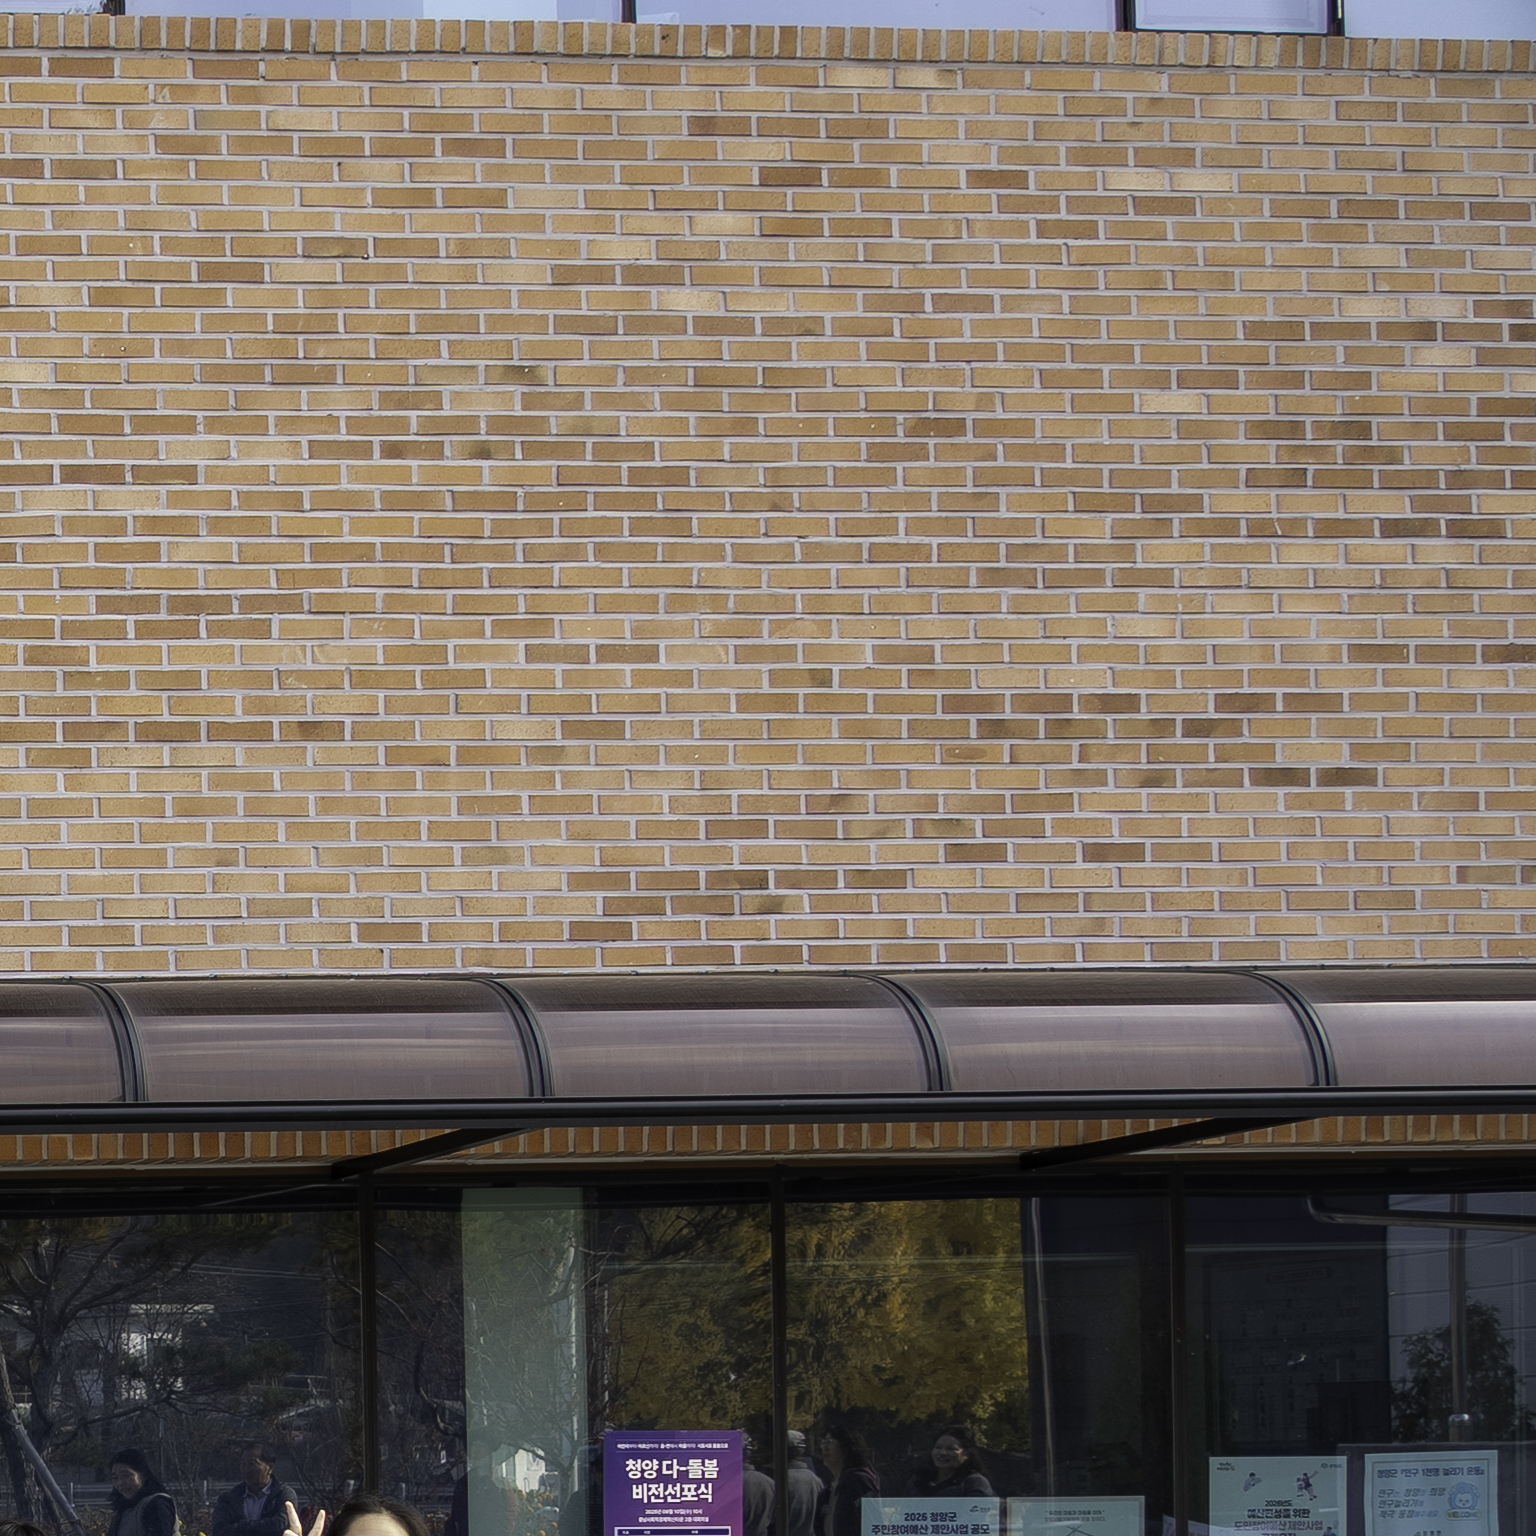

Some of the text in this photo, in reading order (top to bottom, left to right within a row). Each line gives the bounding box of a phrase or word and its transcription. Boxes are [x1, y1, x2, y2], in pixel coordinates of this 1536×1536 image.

[625, 1458, 720, 1479] 청양 다-돌봄
[632, 1482, 714, 1504] 비전선포식
[904, 1512, 957, 1521] 2026 청양군
[1292, 1508, 1311, 1519] 위한
[871, 1524, 990, 1535] 주민참여예산 제안사업 공모
